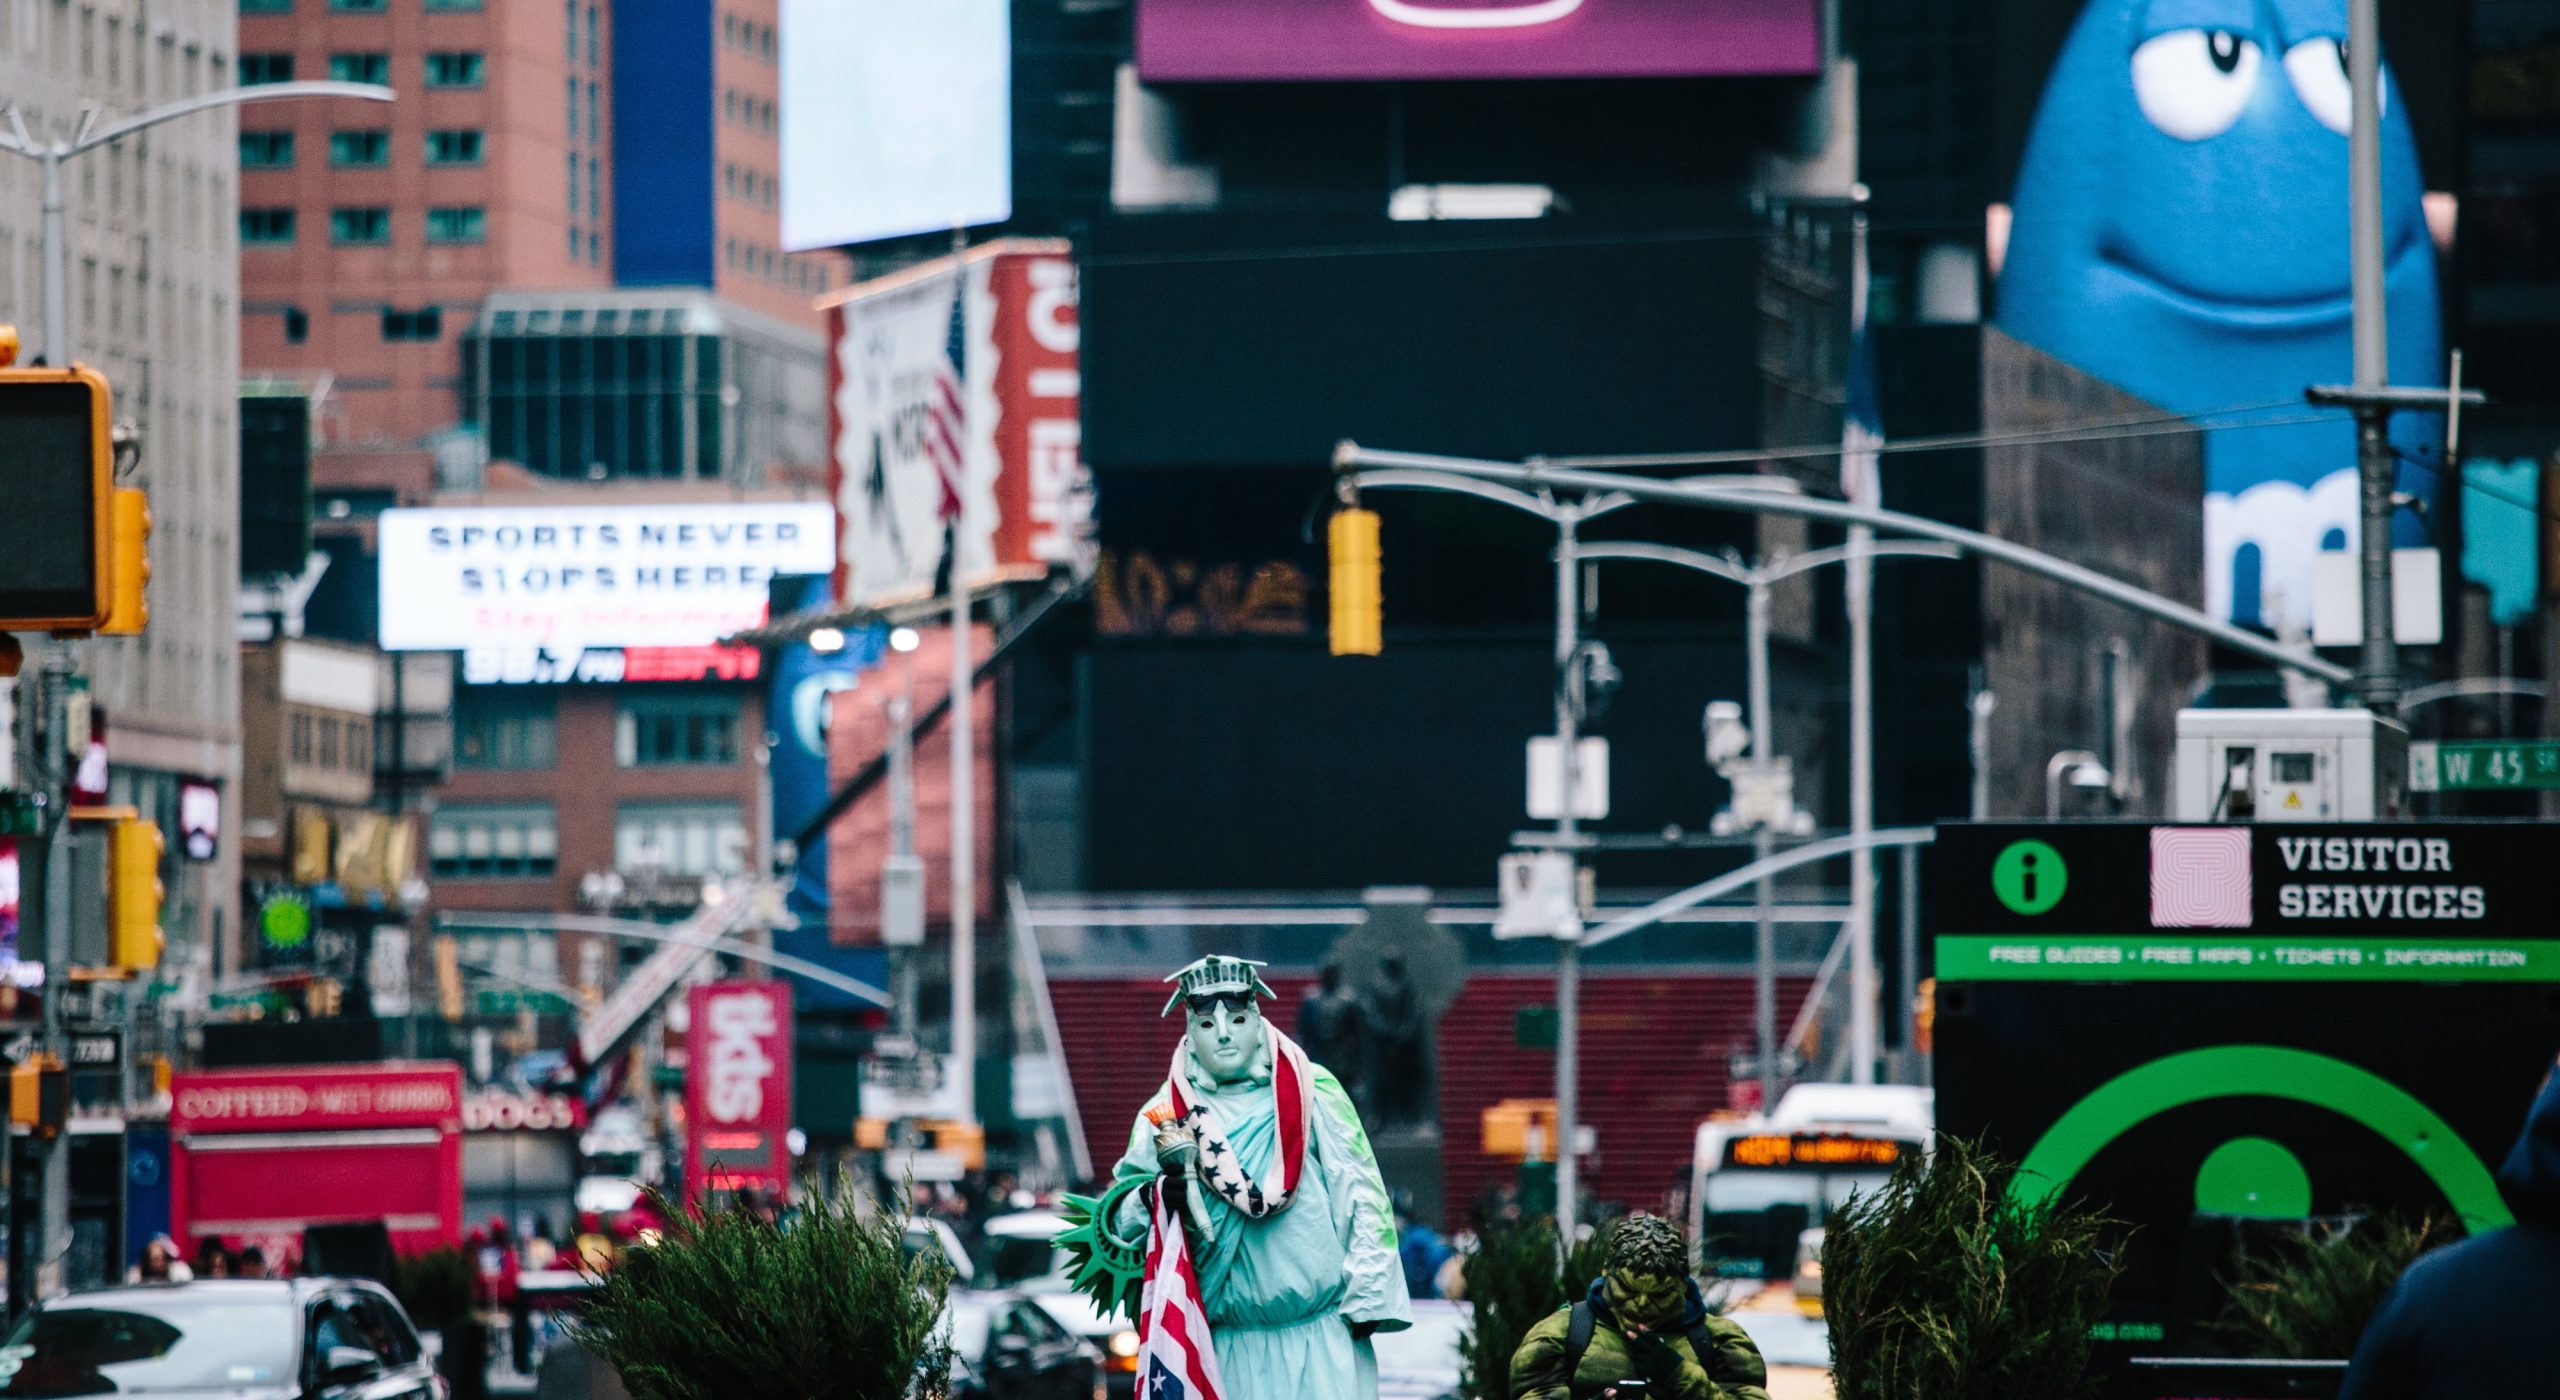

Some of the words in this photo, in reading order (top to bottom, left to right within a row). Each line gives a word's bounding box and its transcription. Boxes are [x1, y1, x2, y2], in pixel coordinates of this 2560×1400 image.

[428, 523, 621, 550] SPORTS
[639, 521, 800, 547] NEVER
[461, 565, 617, 593] STOPS
[2444, 753, 2473, 783] W
[2487, 751, 2522, 784] 45
[2277, 837, 2452, 871] VISITOR
[2278, 884, 2485, 919] SERVICES
[1989, 945, 2041, 963] FREE
[2045, 945, 2122, 964] GUIDES
[2141, 946, 2193, 965] FREE
[2198, 946, 2252, 965] MAPS
[2275, 947, 2361, 966] TICKETS
[2384, 948, 2527, 967] INFORMATION
